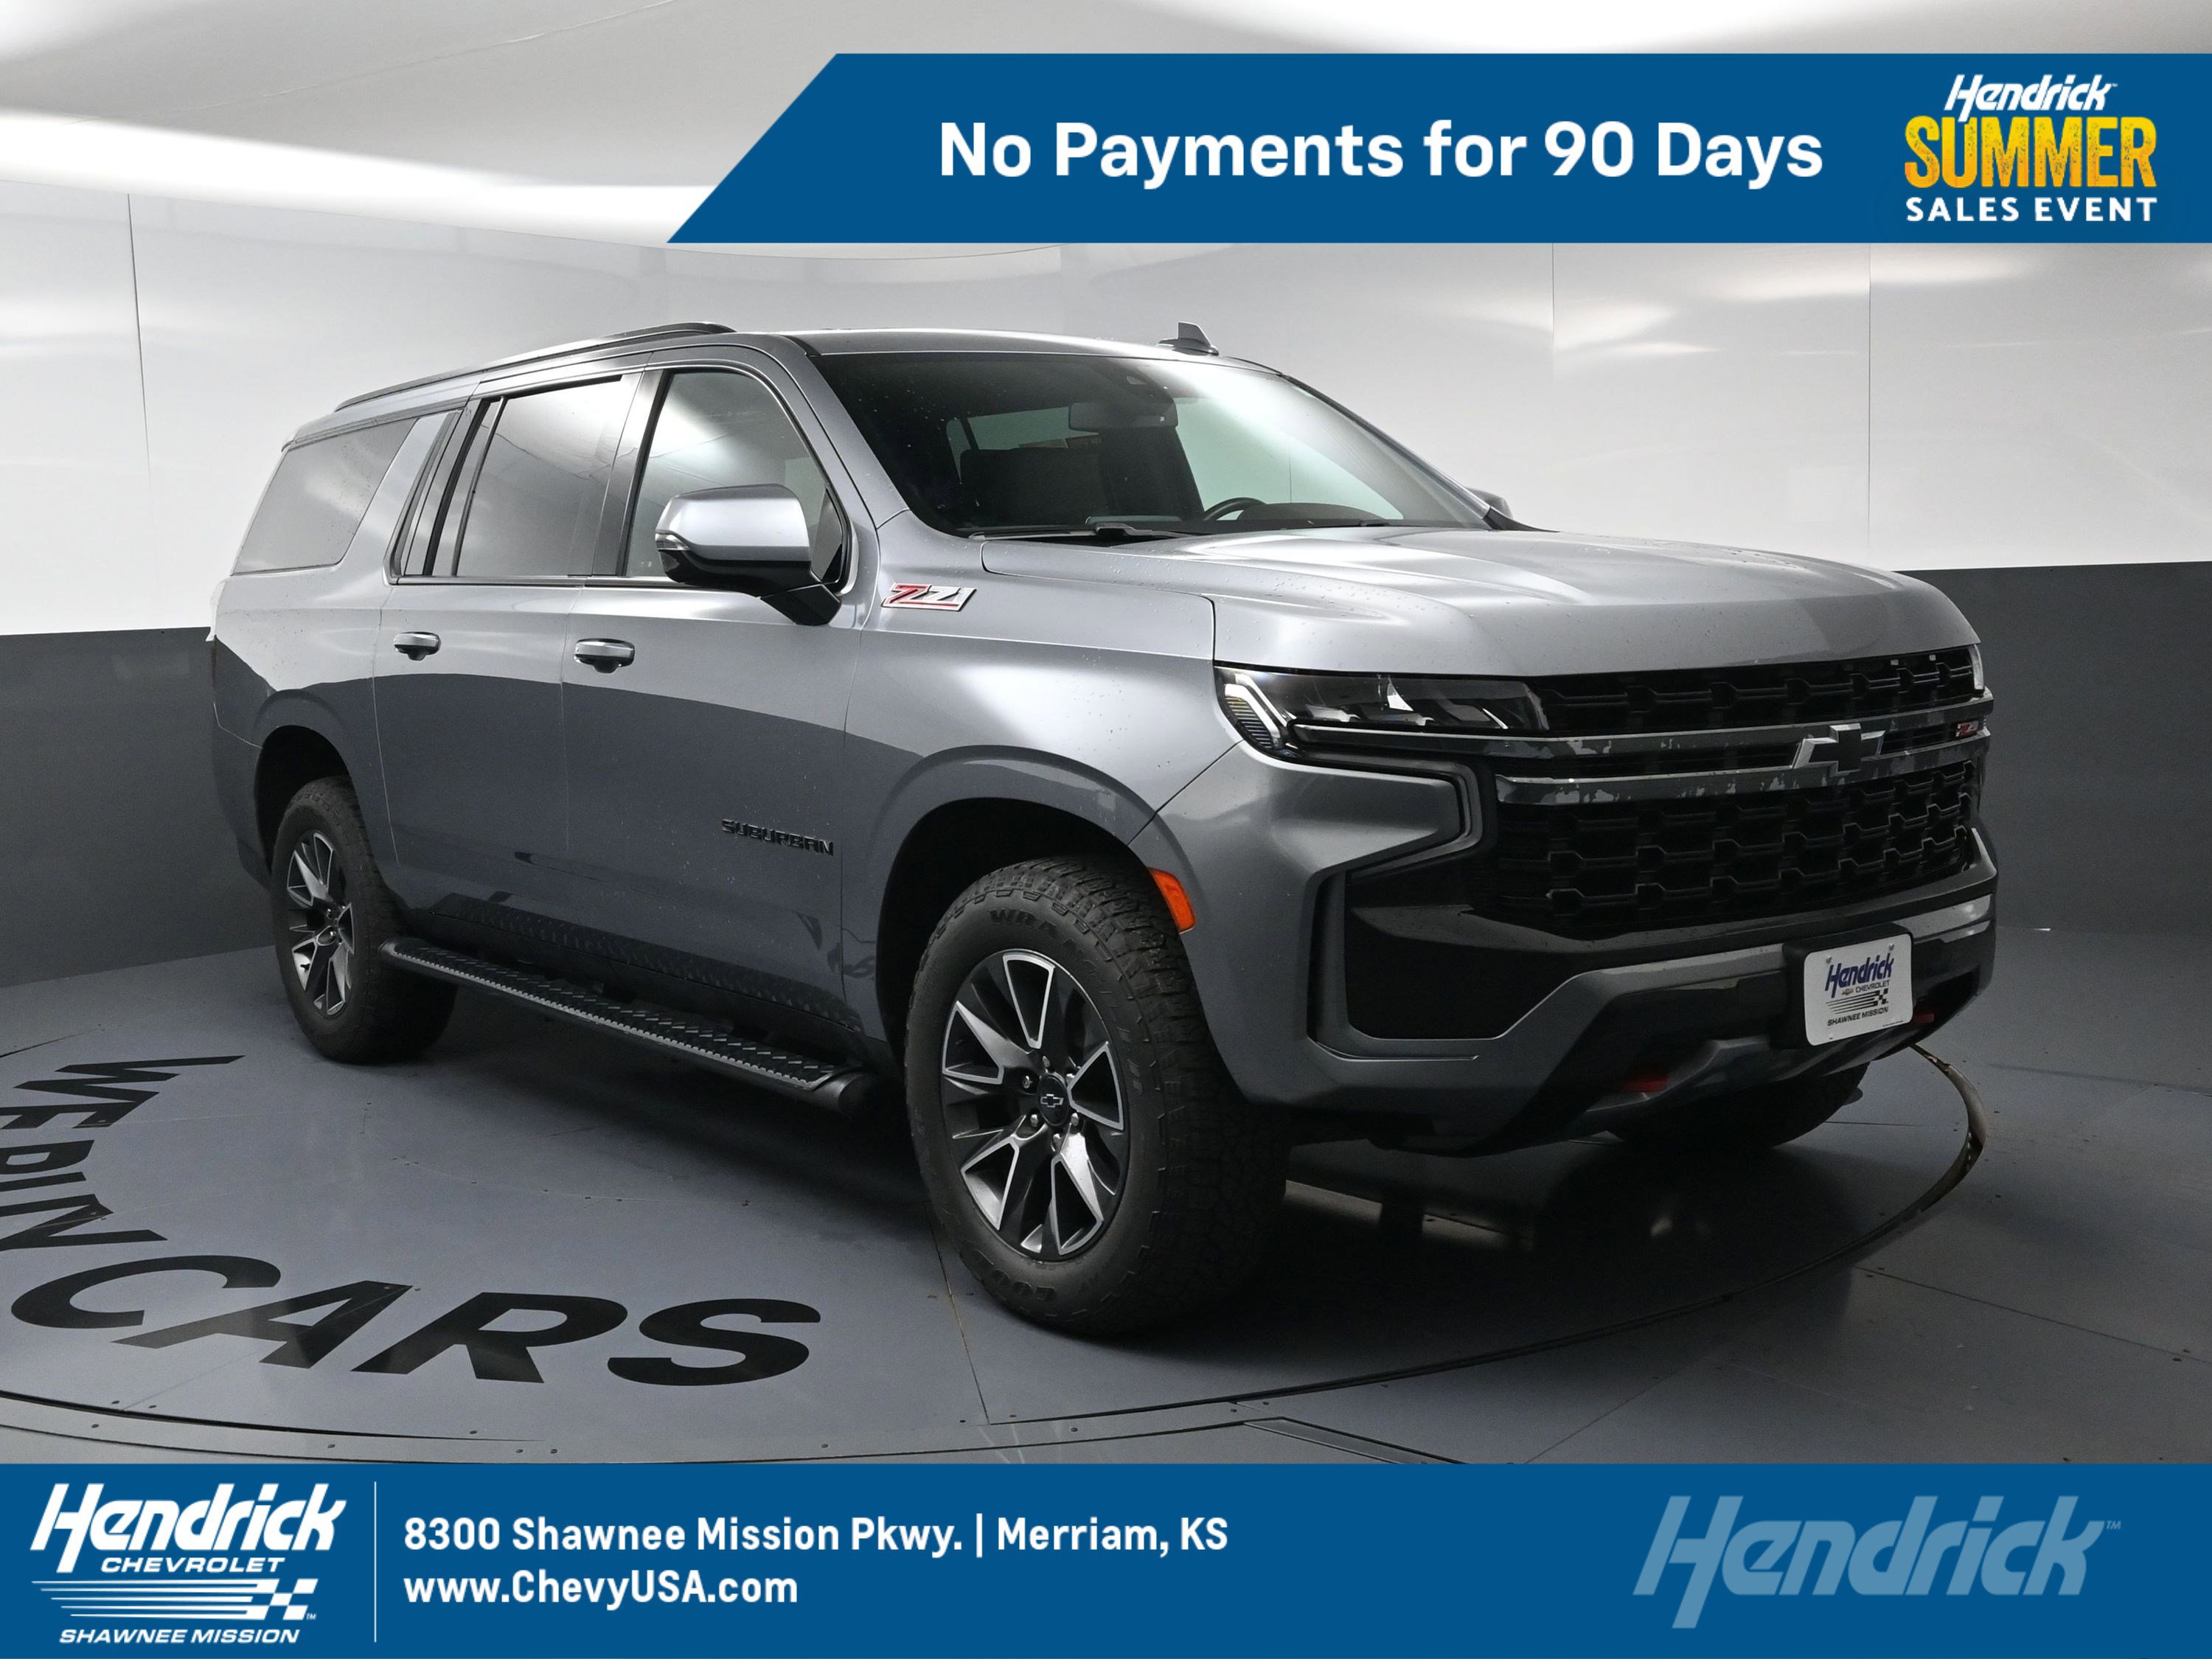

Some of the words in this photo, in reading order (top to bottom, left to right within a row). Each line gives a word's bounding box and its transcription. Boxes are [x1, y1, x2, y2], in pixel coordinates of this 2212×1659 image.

[883, 582, 977, 611] Z71
[722, 818, 833, 855] SUBURBAN
[1825, 953, 1894, 998] Hendrick
[1856, 980, 1890, 993] CHEVROLET
[1828, 1013, 1860, 1026] SHAWNEE
[1862, 1007, 1889, 1018] MISSION
[10, 1255, 821, 1386] CARS
